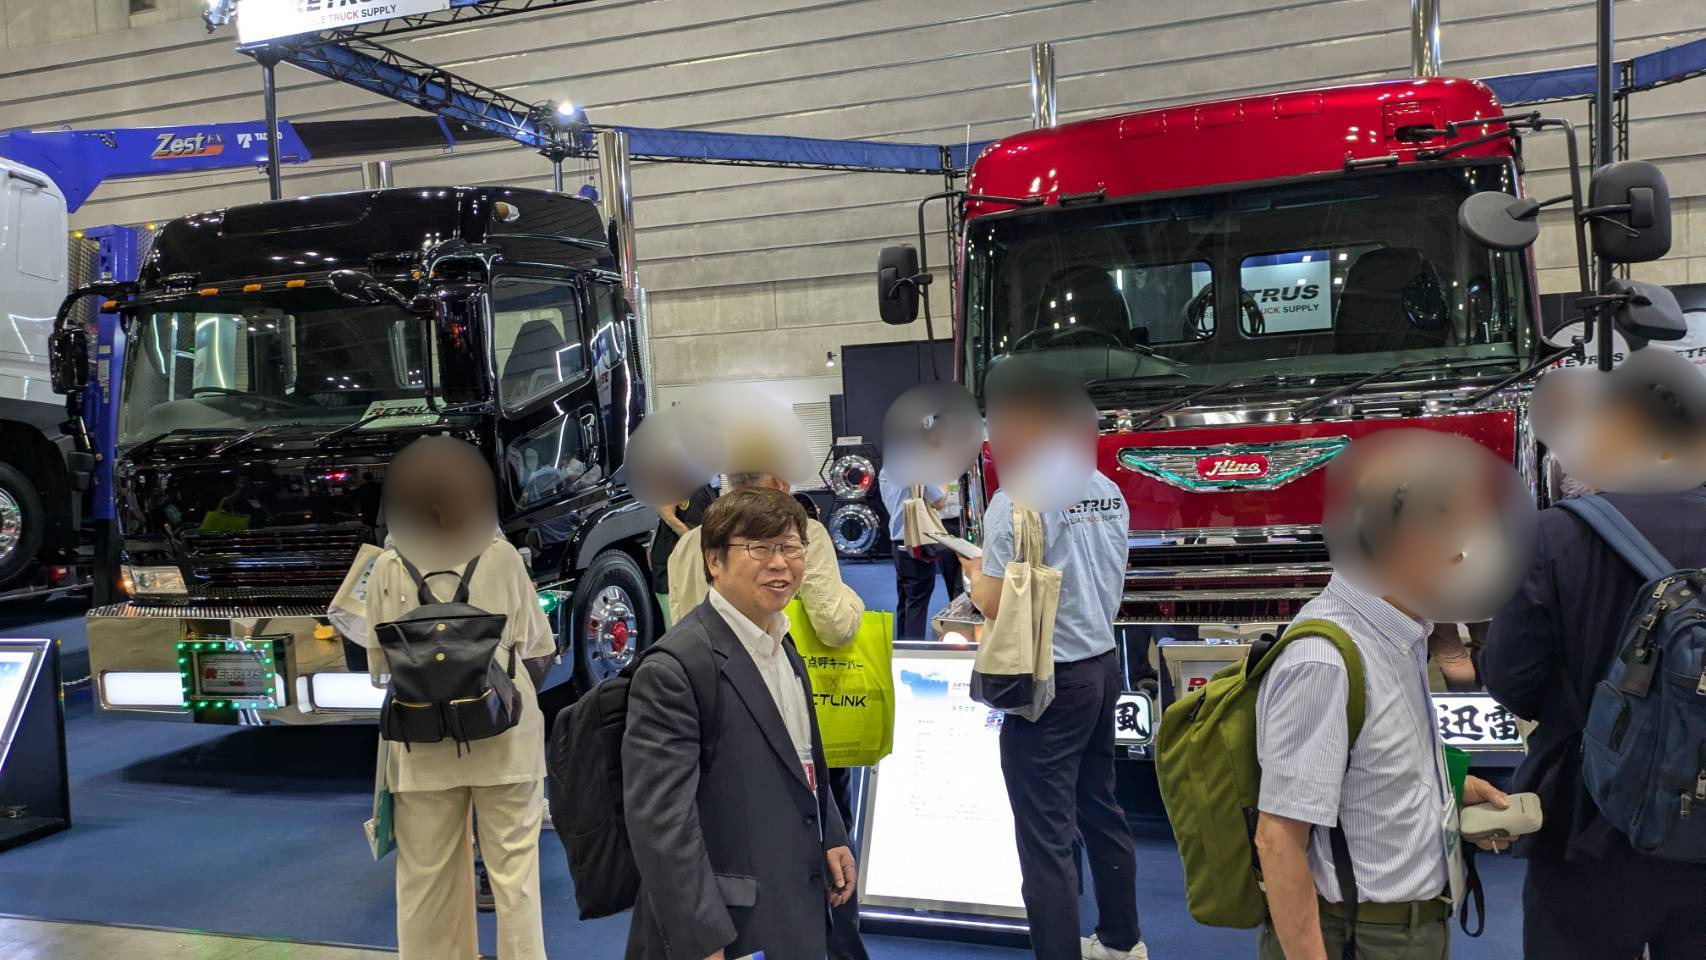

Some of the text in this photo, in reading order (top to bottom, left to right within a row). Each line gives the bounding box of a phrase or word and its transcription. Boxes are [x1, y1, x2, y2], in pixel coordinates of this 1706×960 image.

[328, 10, 359, 22] TRUCK
[360, 4, 397, 18] SUPPLY
[152, 132, 205, 156] Zest
[1247, 284, 1320, 303] TRUS
[1259, 303, 1320, 315] UCK SUPPLY
[1205, 459, 1261, 476] Hino
[1439, 704, 1520, 741] 迅雷
